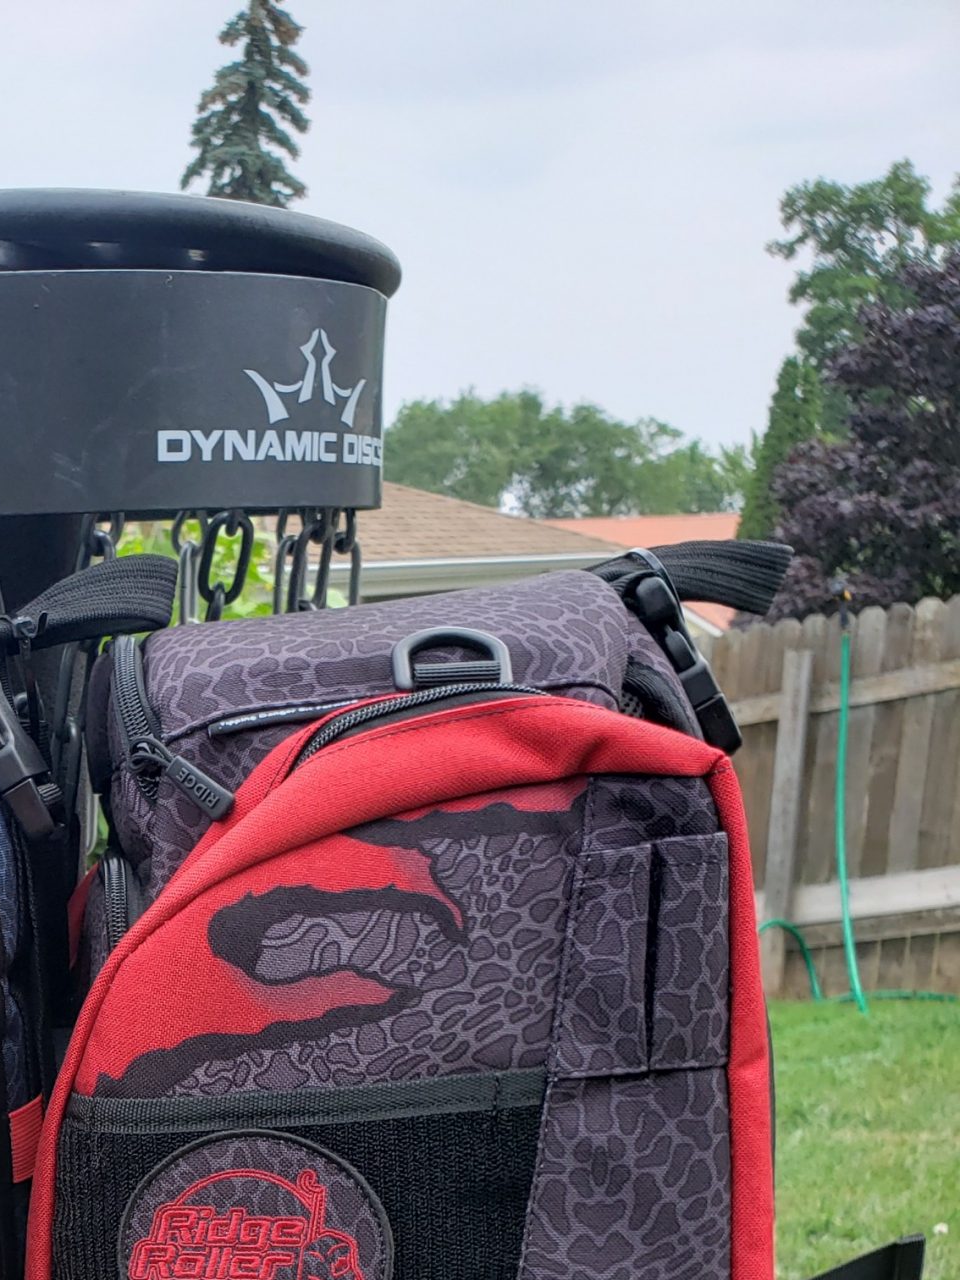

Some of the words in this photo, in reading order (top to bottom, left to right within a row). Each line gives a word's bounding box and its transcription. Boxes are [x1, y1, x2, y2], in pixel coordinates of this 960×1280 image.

[157, 429, 338, 462] DYNAMIC
[343, 433, 382, 467] DISC
[175, 767, 220, 808] RIDGE
[155, 1207, 306, 1250] Ridge
[131, 1243, 296, 1280] Roller
